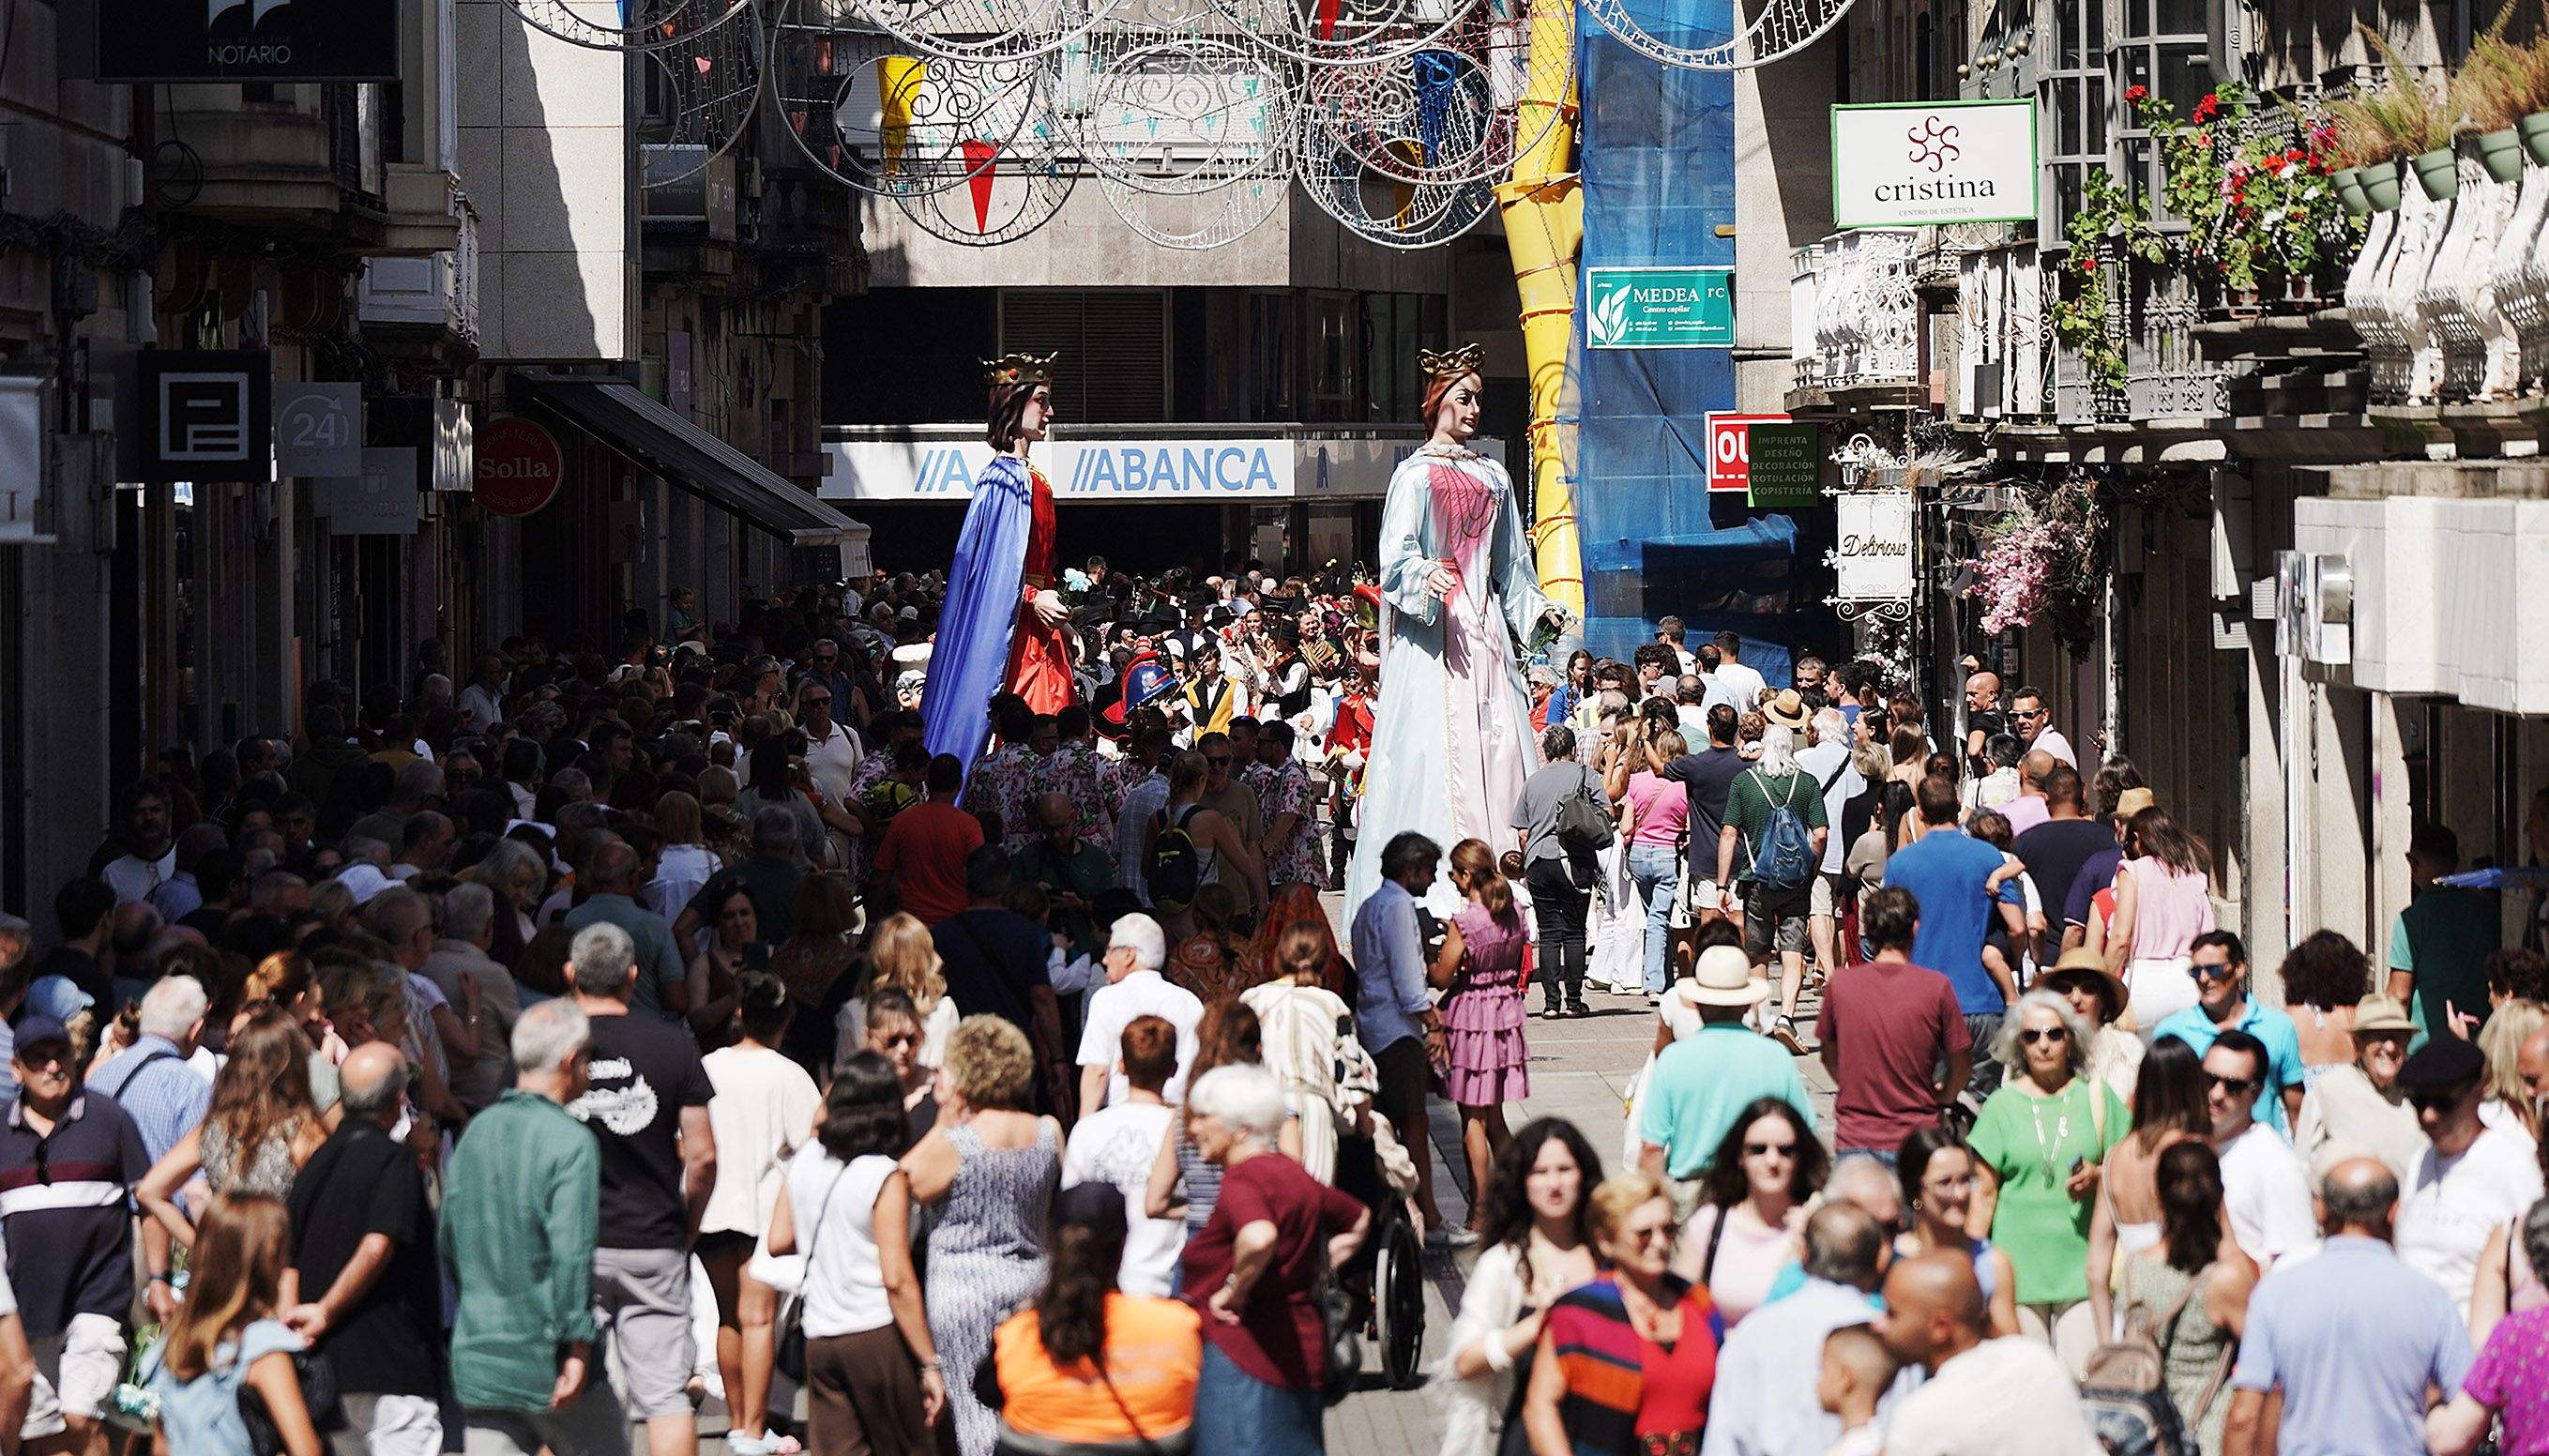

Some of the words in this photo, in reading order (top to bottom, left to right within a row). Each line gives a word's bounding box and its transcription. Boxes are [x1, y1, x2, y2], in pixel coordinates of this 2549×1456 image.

[208, 45, 292, 65] NOTARIO
[1874, 174, 1996, 202] cristina
[1898, 208, 1928, 217] CENTRO
[1633, 288, 1700, 303] MEDEA
[1642, 305, 1666, 313] Centro
[1667, 305, 1691, 314] capilar
[292, 412, 336, 447] 24
[1757, 436, 1808, 445] IMPRENTA
[1765, 447, 1803, 458] DESEÑO
[478, 457, 551, 478] Solla
[1752, 460, 1815, 470] DECORACIÓN
[1752, 472, 1815, 482] ROTULACIÓN
[1753, 482, 1813, 495] COPISTERÍA
[1841, 534, 1907, 557] Delirious
